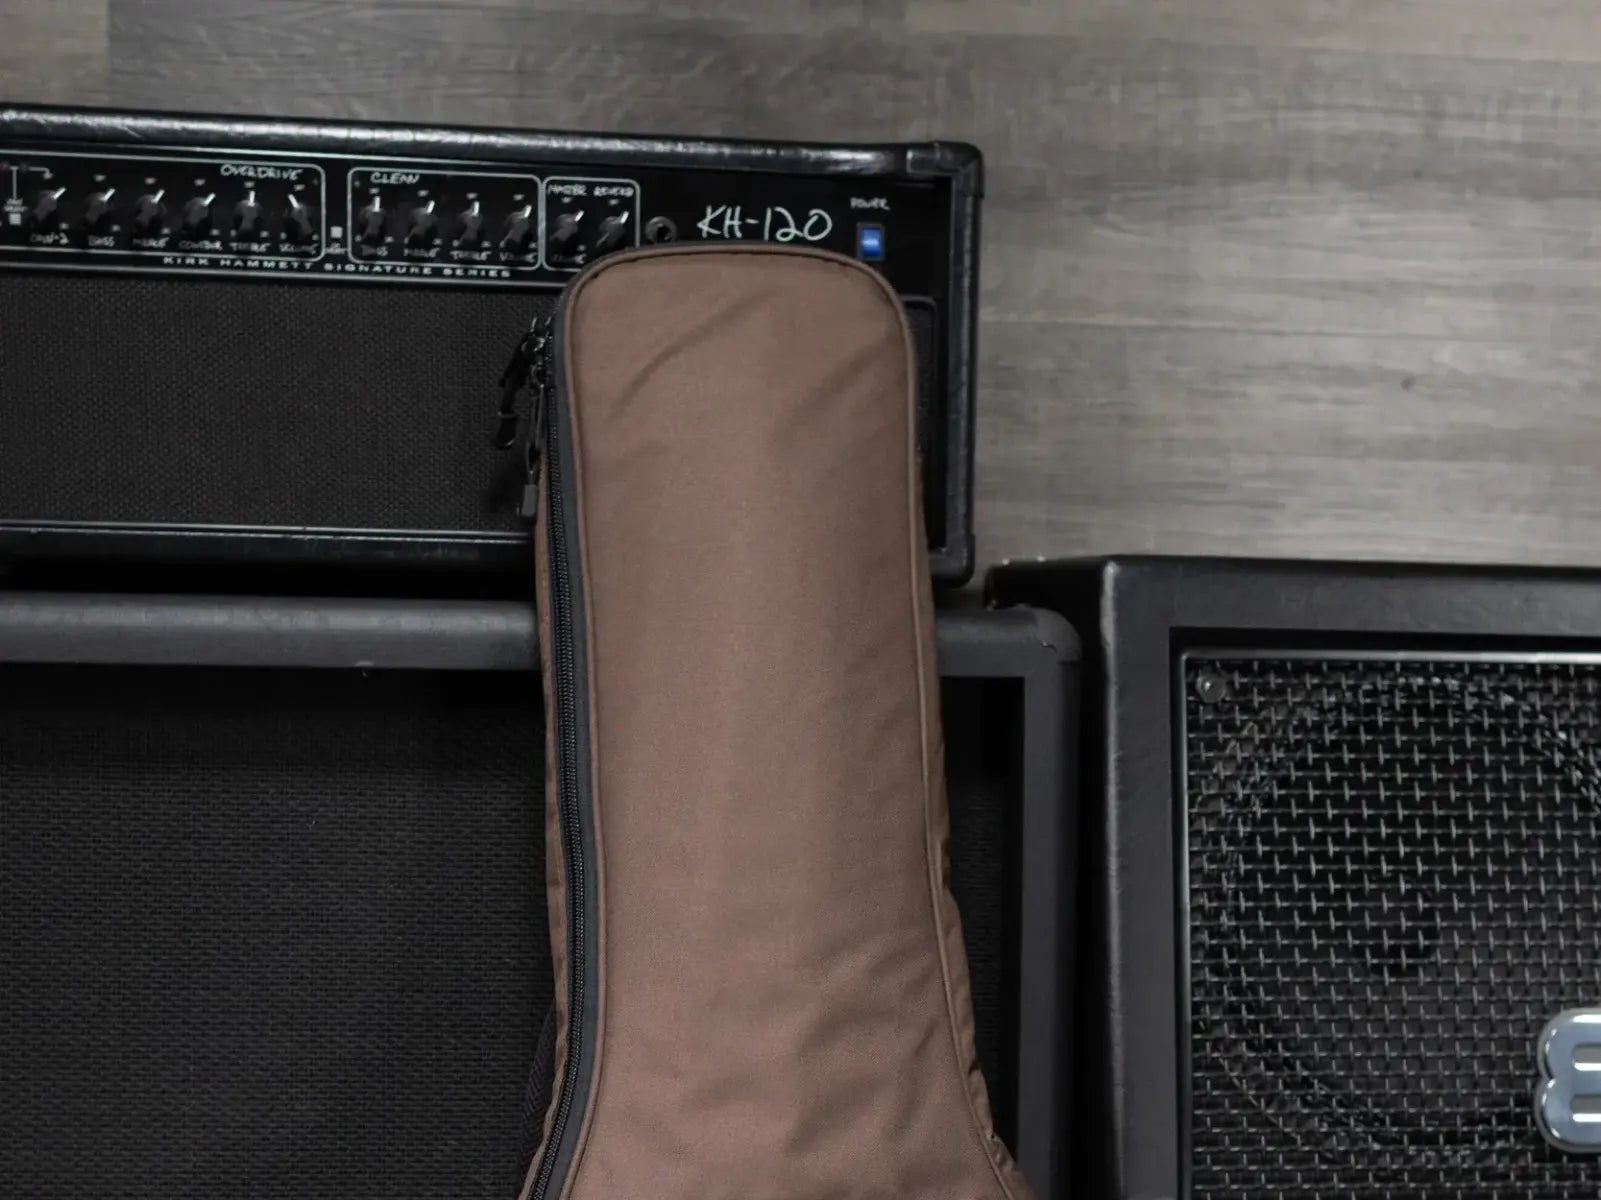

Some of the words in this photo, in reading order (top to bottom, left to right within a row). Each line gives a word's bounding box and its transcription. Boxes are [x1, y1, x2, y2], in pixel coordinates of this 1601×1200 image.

[220, 164, 303, 181] OVERDRIVE
[370, 172, 420, 185] CLEAN
[850, 197, 890, 211] POWER
[697, 204, 833, 242] KH-120
[163, 256, 209, 266] KIRK
[220, 259, 313, 271] HAMMETT
[323, 263, 432, 275] SIGNATURE
[442, 267, 511, 278] SERIES
